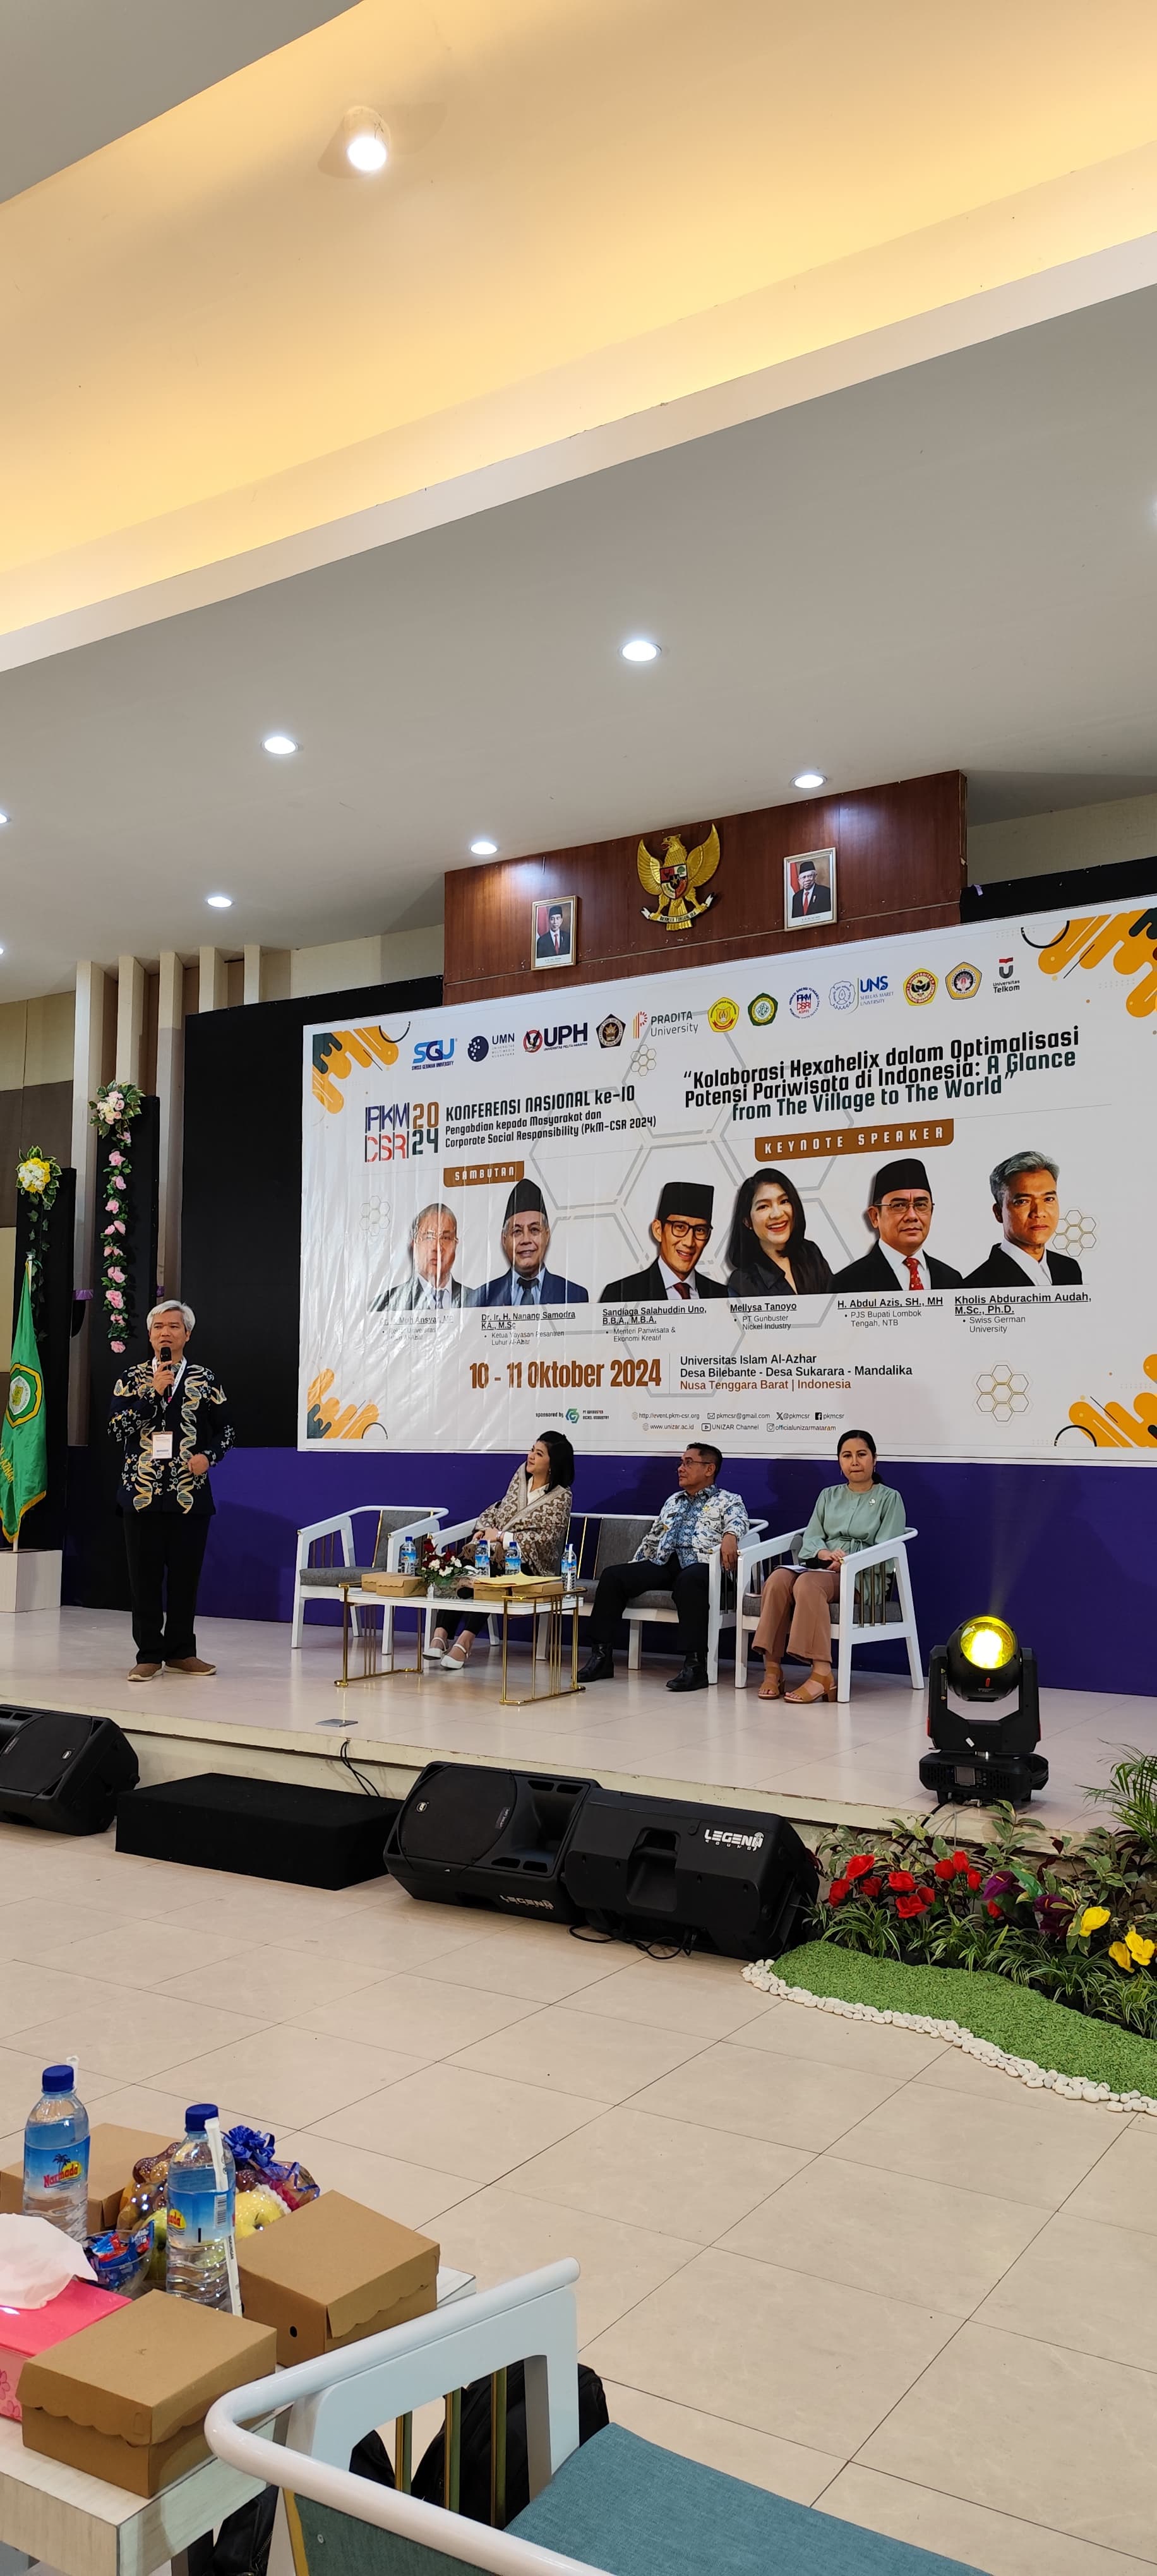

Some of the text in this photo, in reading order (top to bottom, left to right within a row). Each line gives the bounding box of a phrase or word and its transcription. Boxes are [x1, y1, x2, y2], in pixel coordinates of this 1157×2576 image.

[860, 975, 888, 992] UNS
[993, 985, 1020, 994] Telkom
[651, 1011, 692, 1025] PRADITA
[544, 1022, 588, 1047] UPH
[650, 1022, 698, 1037] University
[492, 1033, 515, 1044] UMN
[413, 1039, 455, 1064] SGU
[791, 1051, 879, 1078] Hexahelix
[886, 1046, 944, 1067] dalam
[950, 1025, 1078, 1061] Optimalisasi
[685, 1051, 1076, 1107] Potensi Pariwisata di Indonesia: A Glance
[446, 1099, 520, 1122] KONFERENSI
[525, 1090, 590, 1113] NASIONAL
[733, 1103, 771, 1121] from
[777, 1097, 807, 1116] The
[813, 1091, 875, 1112] Village
[881, 1088, 899, 1106] to
[905, 1083, 938, 1102] The
[365, 1101, 439, 1133] PKM 20
[445, 1111, 601, 1135] Pengabdian kepada Masyarakat dan
[445, 1115, 656, 1148] Corporate Social Responsibility (PkM-CSR 2024)
[365, 1128, 438, 1162] CSR 24
[765, 1127, 943, 1154] KEYNOTE SPEAKER
[455, 1166, 514, 1181] SAMBUTAN
[850, 1299, 877, 1308] Abdul
[880, 1298, 902, 1307] Azis,
[905, 1297, 925, 1306] SH.,
[927, 1297, 943, 1305] MH
[955, 1292, 1091, 1304] Kholis Abdurachim Audah,
[602, 1305, 707, 1317] Sandiaga Salahuddin Uno,
[730, 1303, 797, 1313] Mellysa Tanoyo
[868, 1310, 890, 1319] Bupati
[955, 1305, 1014, 1315] M.Sc., Ph.D.
[513, 1312, 540, 1321] Nanang
[543, 1311, 575, 1319] Samodra
[632, 1316, 657, 1324] M.B.A.
[851, 1320, 880, 1328] Tengah,
[969, 1325, 1007, 1333] University
[680, 1354, 817, 1366] Universitas Islam Al-Azhar
[470, 1362, 489, 1388] 10
[507, 1362, 522, 1388] 11
[527, 1361, 604, 1388] Oktober
[610, 1359, 661, 1387] 2024
[680, 1368, 705, 1378] Desa
[709, 1367, 757, 1377] Bilebante
[765, 1367, 793, 1376] Desa
[796, 1366, 845, 1376] Sukarara
[854, 1364, 913, 1375] Mandalika
[680, 1381, 706, 1390] Nusa
[709, 1380, 757, 1392] Tenggara
[760, 1380, 789, 1390] Barat
[798, 1379, 851, 1390] Indonesia
[824, 1412, 844, 1420] pkmcsr
[44, 2164, 78, 2188] Narmada
